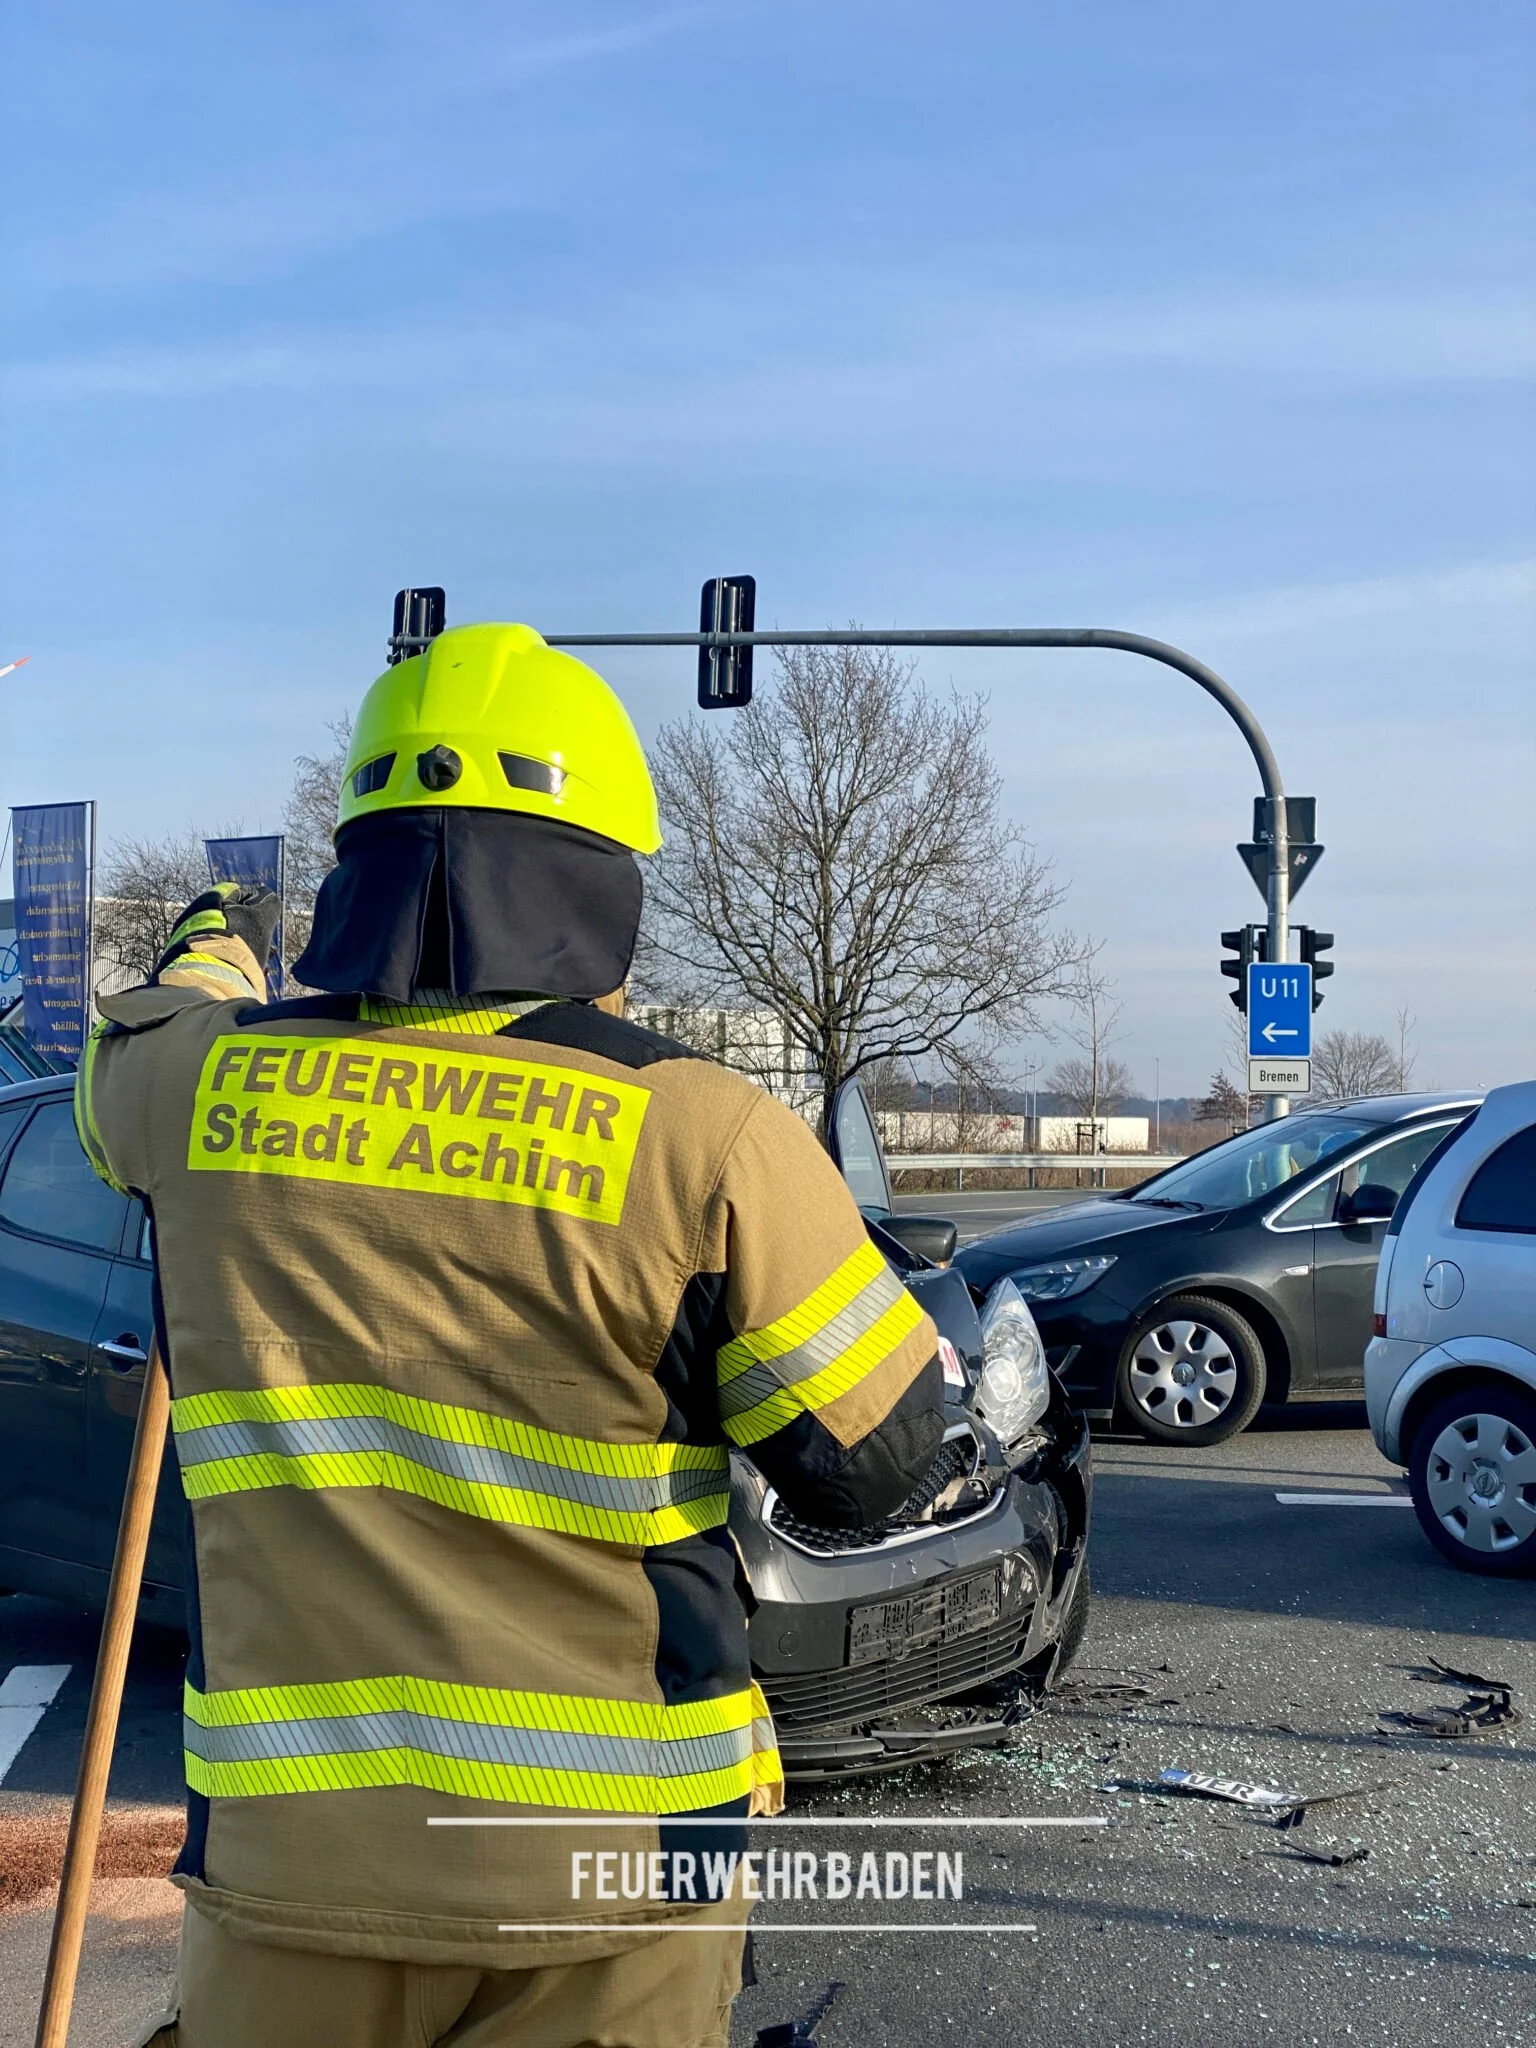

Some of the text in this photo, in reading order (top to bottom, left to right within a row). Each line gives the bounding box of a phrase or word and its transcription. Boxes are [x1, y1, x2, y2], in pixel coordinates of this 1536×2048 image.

[211, 1046, 621, 1142] FEUERWEHR
[1260, 1070, 1299, 1082] Bremen
[202, 1102, 606, 1203] Stadt Achim
